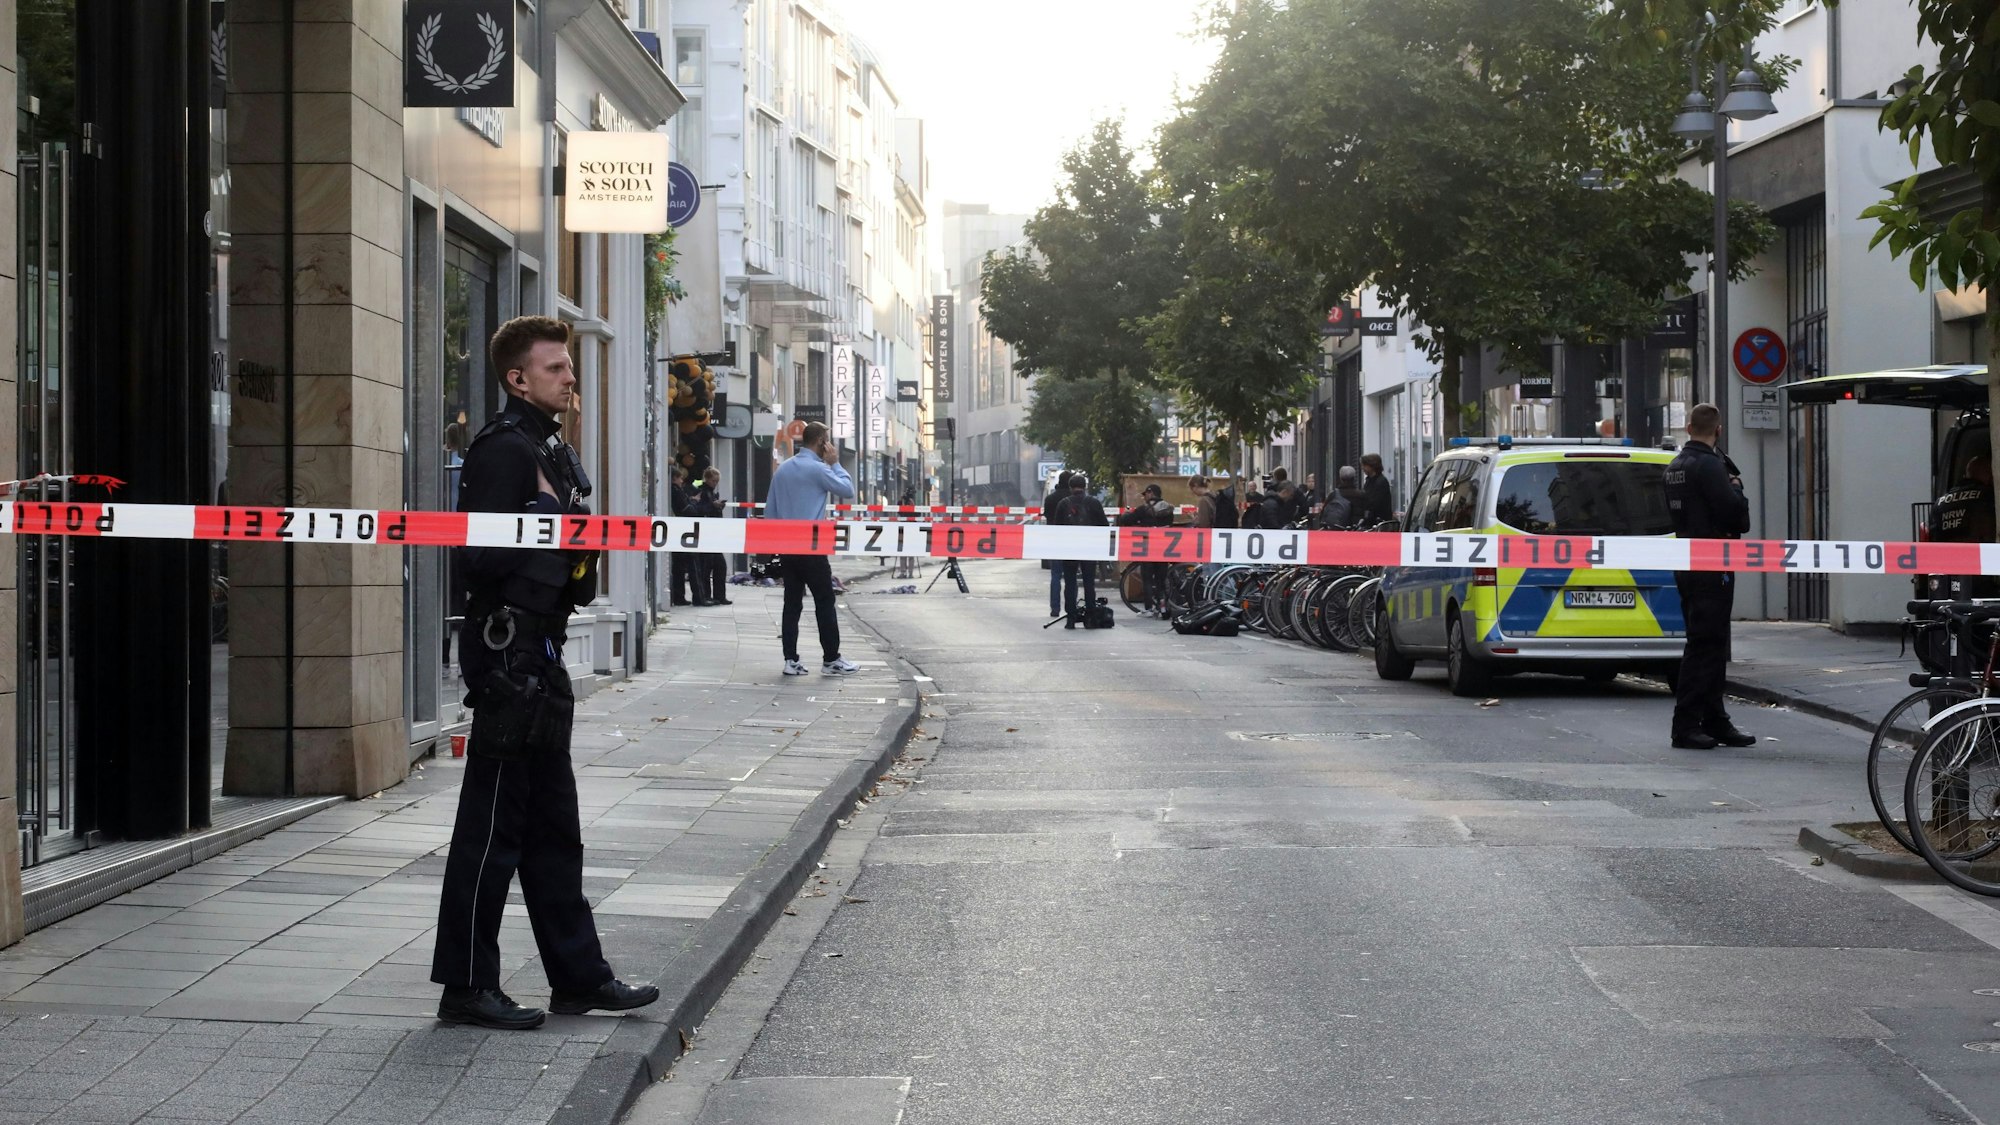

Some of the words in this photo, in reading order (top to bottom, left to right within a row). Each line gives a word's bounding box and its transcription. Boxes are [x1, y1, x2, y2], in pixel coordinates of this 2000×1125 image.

[580, 161, 652, 175] SCOTCH
[579, 193, 653, 202] AMSTERDAM
[582, 178, 596, 191] &
[601, 178, 652, 191] SODA
[940, 328, 948, 337] &
[836, 348, 848, 436] ARKET
[871, 367, 882, 449] ARKET
[1938, 490, 1981, 506] POLIZEI
[0, 503, 114, 532] POLI
[223, 510, 406, 541] POLIZEI
[1942, 509, 1966, 520] NRW
[1942, 518, 1962, 530] DHF
[515, 517, 700, 548] POLIZEI
[811, 524, 997, 554] POLIZEI
[1108, 530, 1298, 560] POLIZEI
[1413, 536, 1605, 565] POLIZEI
[1722, 542, 1917, 569] POLIZEI
[1571, 592, 1591, 604] NRW
[1597, 592, 1634, 604] 4-7009
